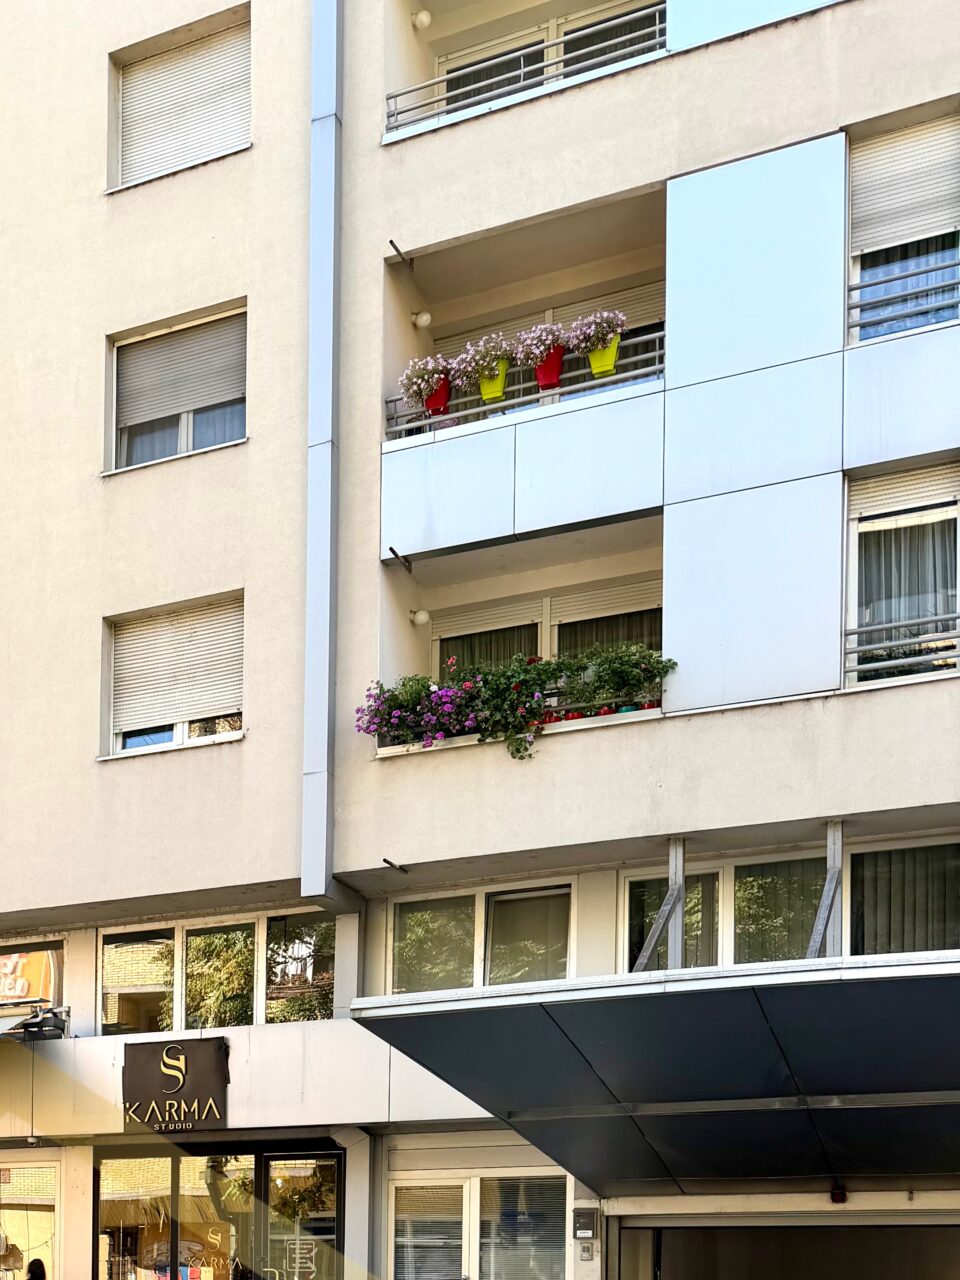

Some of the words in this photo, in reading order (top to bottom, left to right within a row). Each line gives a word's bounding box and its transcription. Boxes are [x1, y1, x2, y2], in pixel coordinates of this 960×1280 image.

[126, 1097, 221, 1123] KARMA
[154, 1122, 193, 1131] STUDIO
[188, 1256, 243, 1270] KARMA
